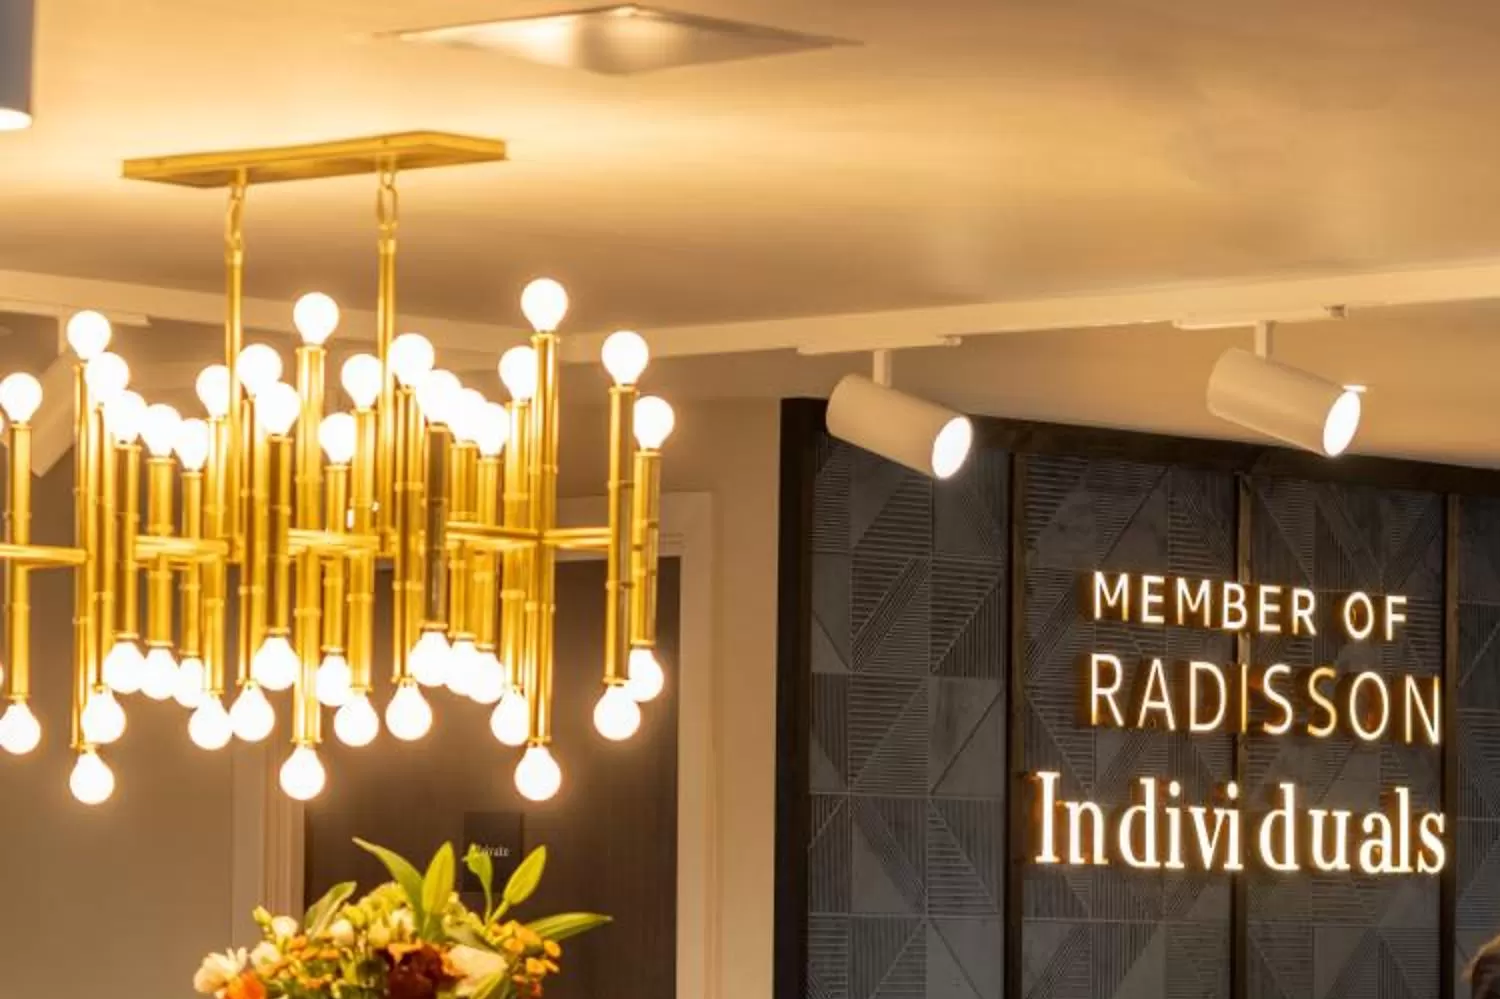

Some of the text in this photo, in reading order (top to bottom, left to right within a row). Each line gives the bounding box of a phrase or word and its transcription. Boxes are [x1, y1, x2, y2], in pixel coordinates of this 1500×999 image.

[1093, 570, 1408, 642] MEMBER OF
[1090, 652, 1441, 746] RADISSON
[1034, 771, 1446, 875] Individuals
